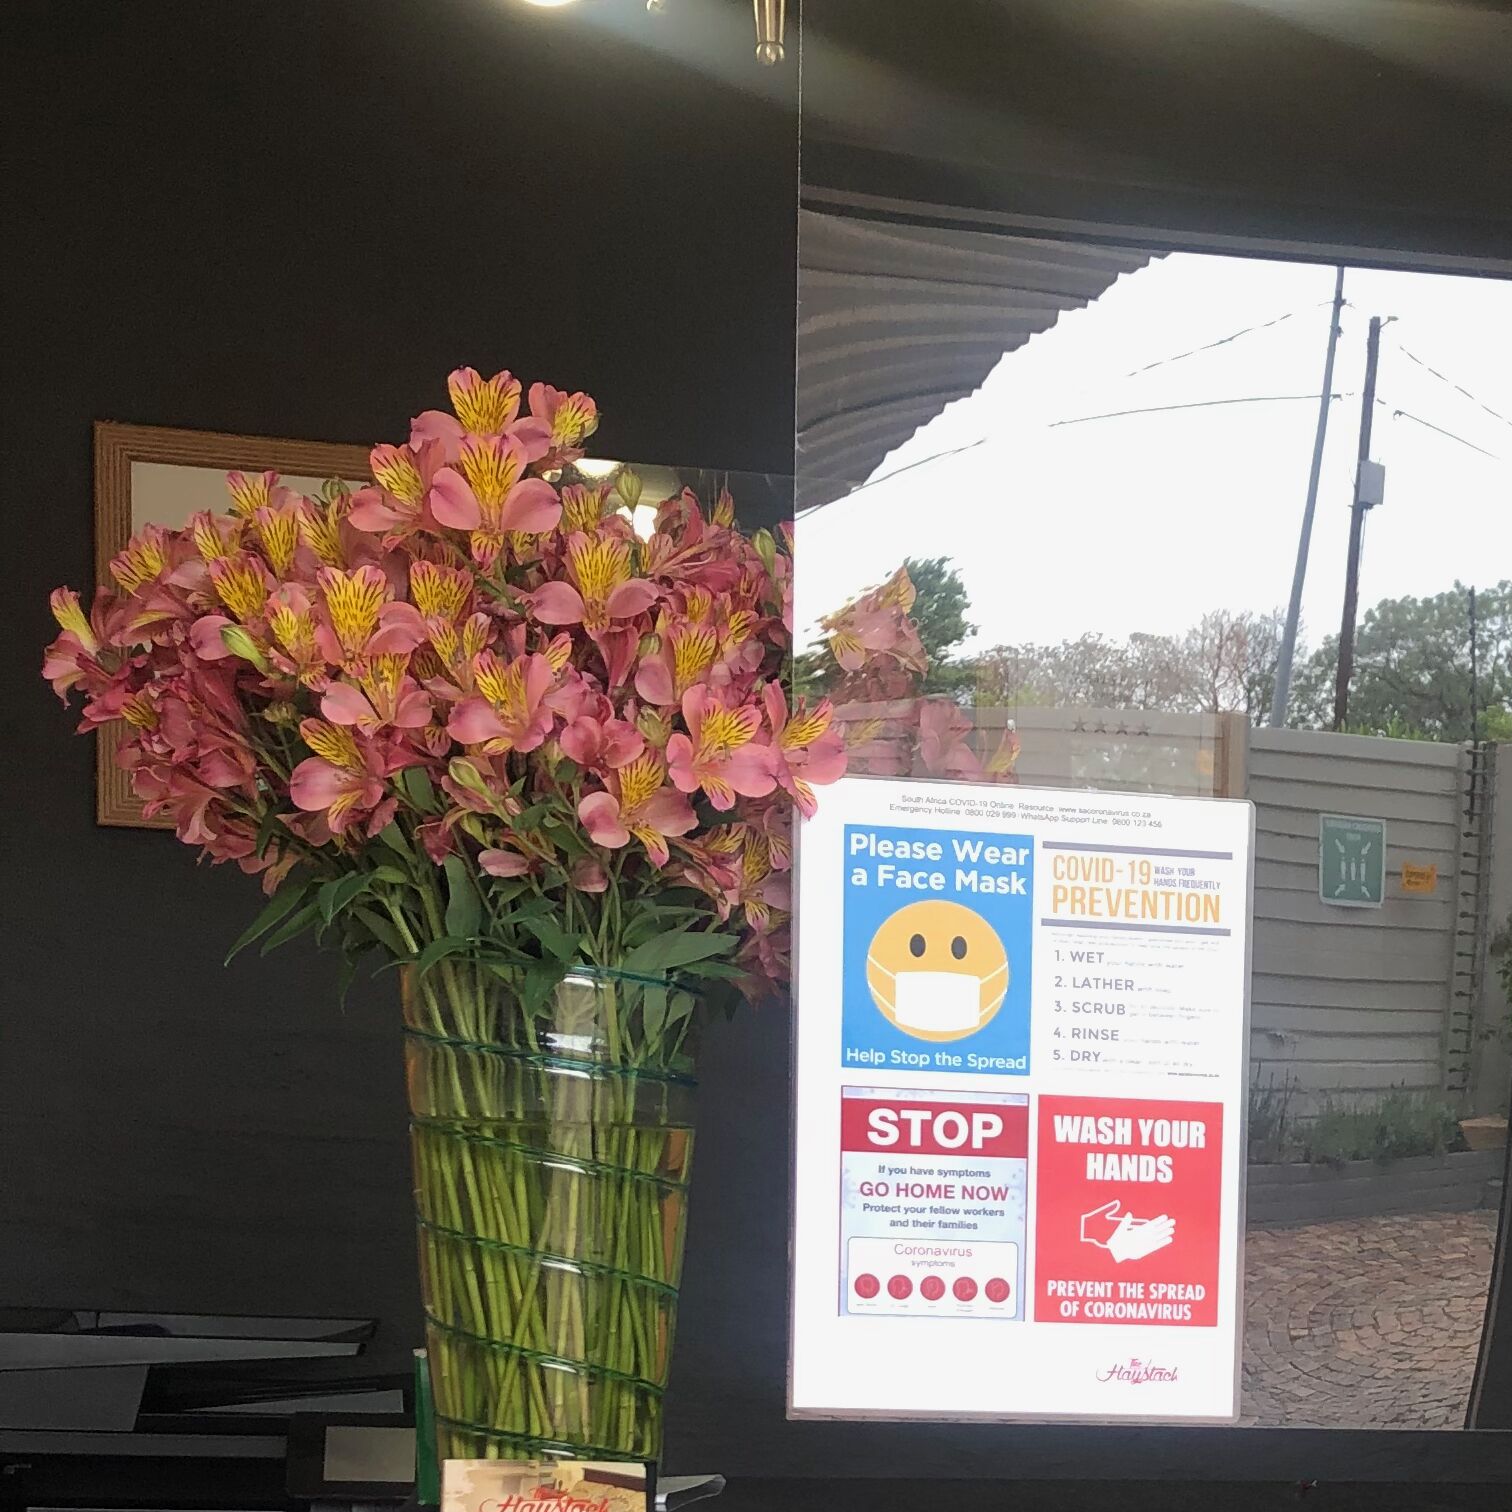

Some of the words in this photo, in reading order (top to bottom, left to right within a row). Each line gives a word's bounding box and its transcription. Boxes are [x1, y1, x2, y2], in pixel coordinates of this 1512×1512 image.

[889, 804, 932, 814] Emergency
[986, 810, 1000, 818] 029
[1021, 813, 1059, 822] WhatsApp
[1061, 815, 1091, 823] Support
[902, 795, 923, 803] South
[925, 797, 947, 805] Africa
[949, 799, 987, 807] COVID-19
[990, 801, 1014, 809] Online
[1020, 803, 1054, 811] Resource
[1059, 807, 1152, 818] wwwsacoronaviruscoza
[850, 833, 943, 862] Please
[952, 839, 1030, 867] Wear
[851, 868, 868, 886] a
[876, 864, 946, 891] Face
[955, 868, 1027, 896] Mask
[1052, 855, 1151, 886] COVID-19
[1154, 866, 1174, 875] WASH
[1178, 868, 1195, 876] YOUR
[1153, 878, 1177, 887] HANDS
[1179, 879, 1221, 890] FREQUENTLY
[1050, 884, 1221, 923] PREVENTION
[1055, 950, 1065, 962] 1.
[1070, 951, 1105, 963] WET
[1054, 976, 1067, 987] 2.
[1072, 976, 1135, 991] LATHER
[1054, 1000, 1067, 1012] 3.
[1072, 1001, 1126, 1015] SCRUB
[1053, 1027, 1066, 1038] 4.
[1071, 1027, 1120, 1041] RINSE
[846, 1048, 886, 1066] Help
[889, 1050, 931, 1069] Stop
[934, 1052, 964, 1067] the
[966, 1053, 1027, 1071] Spread
[1052, 1049, 1065, 1060] 5.
[1070, 1049, 1101, 1062] DRY
[867, 1107, 1004, 1150] STOP
[1053, 1114, 1132, 1148] WASH
[1138, 1117, 1206, 1149] YOUR
[878, 1165, 886, 1174] If
[888, 1166, 907, 1176] you
[910, 1167, 935, 1176] have
[937, 1168, 991, 1178] symptoms
[1086, 1152, 1174, 1183] HANDS
[860, 1181, 889, 1197] GO
[896, 1182, 956, 1199] HOME
[961, 1185, 1009, 1201] NOW
[863, 1203, 901, 1213] Protect
[903, 1206, 927, 1215] your
[929, 1205, 961, 1215] fellow
[963, 1207, 1005, 1217] workers
[889, 1219, 909, 1227] and
[912, 1219, 935, 1228] their
[937, 1220, 978, 1230] families
[894, 1244, 973, 1257] Coronavirus
[911, 1259, 956, 1268] symptoms
[1047, 1279, 1115, 1300] PREVENT
[1118, 1281, 1146, 1300] THE
[1149, 1281, 1206, 1301] SPREAD
[1060, 1300, 1080, 1317] OF
[1084, 1300, 1192, 1321] CORONAVIRUS
[1095, 1359, 1178, 1385] Haystack
